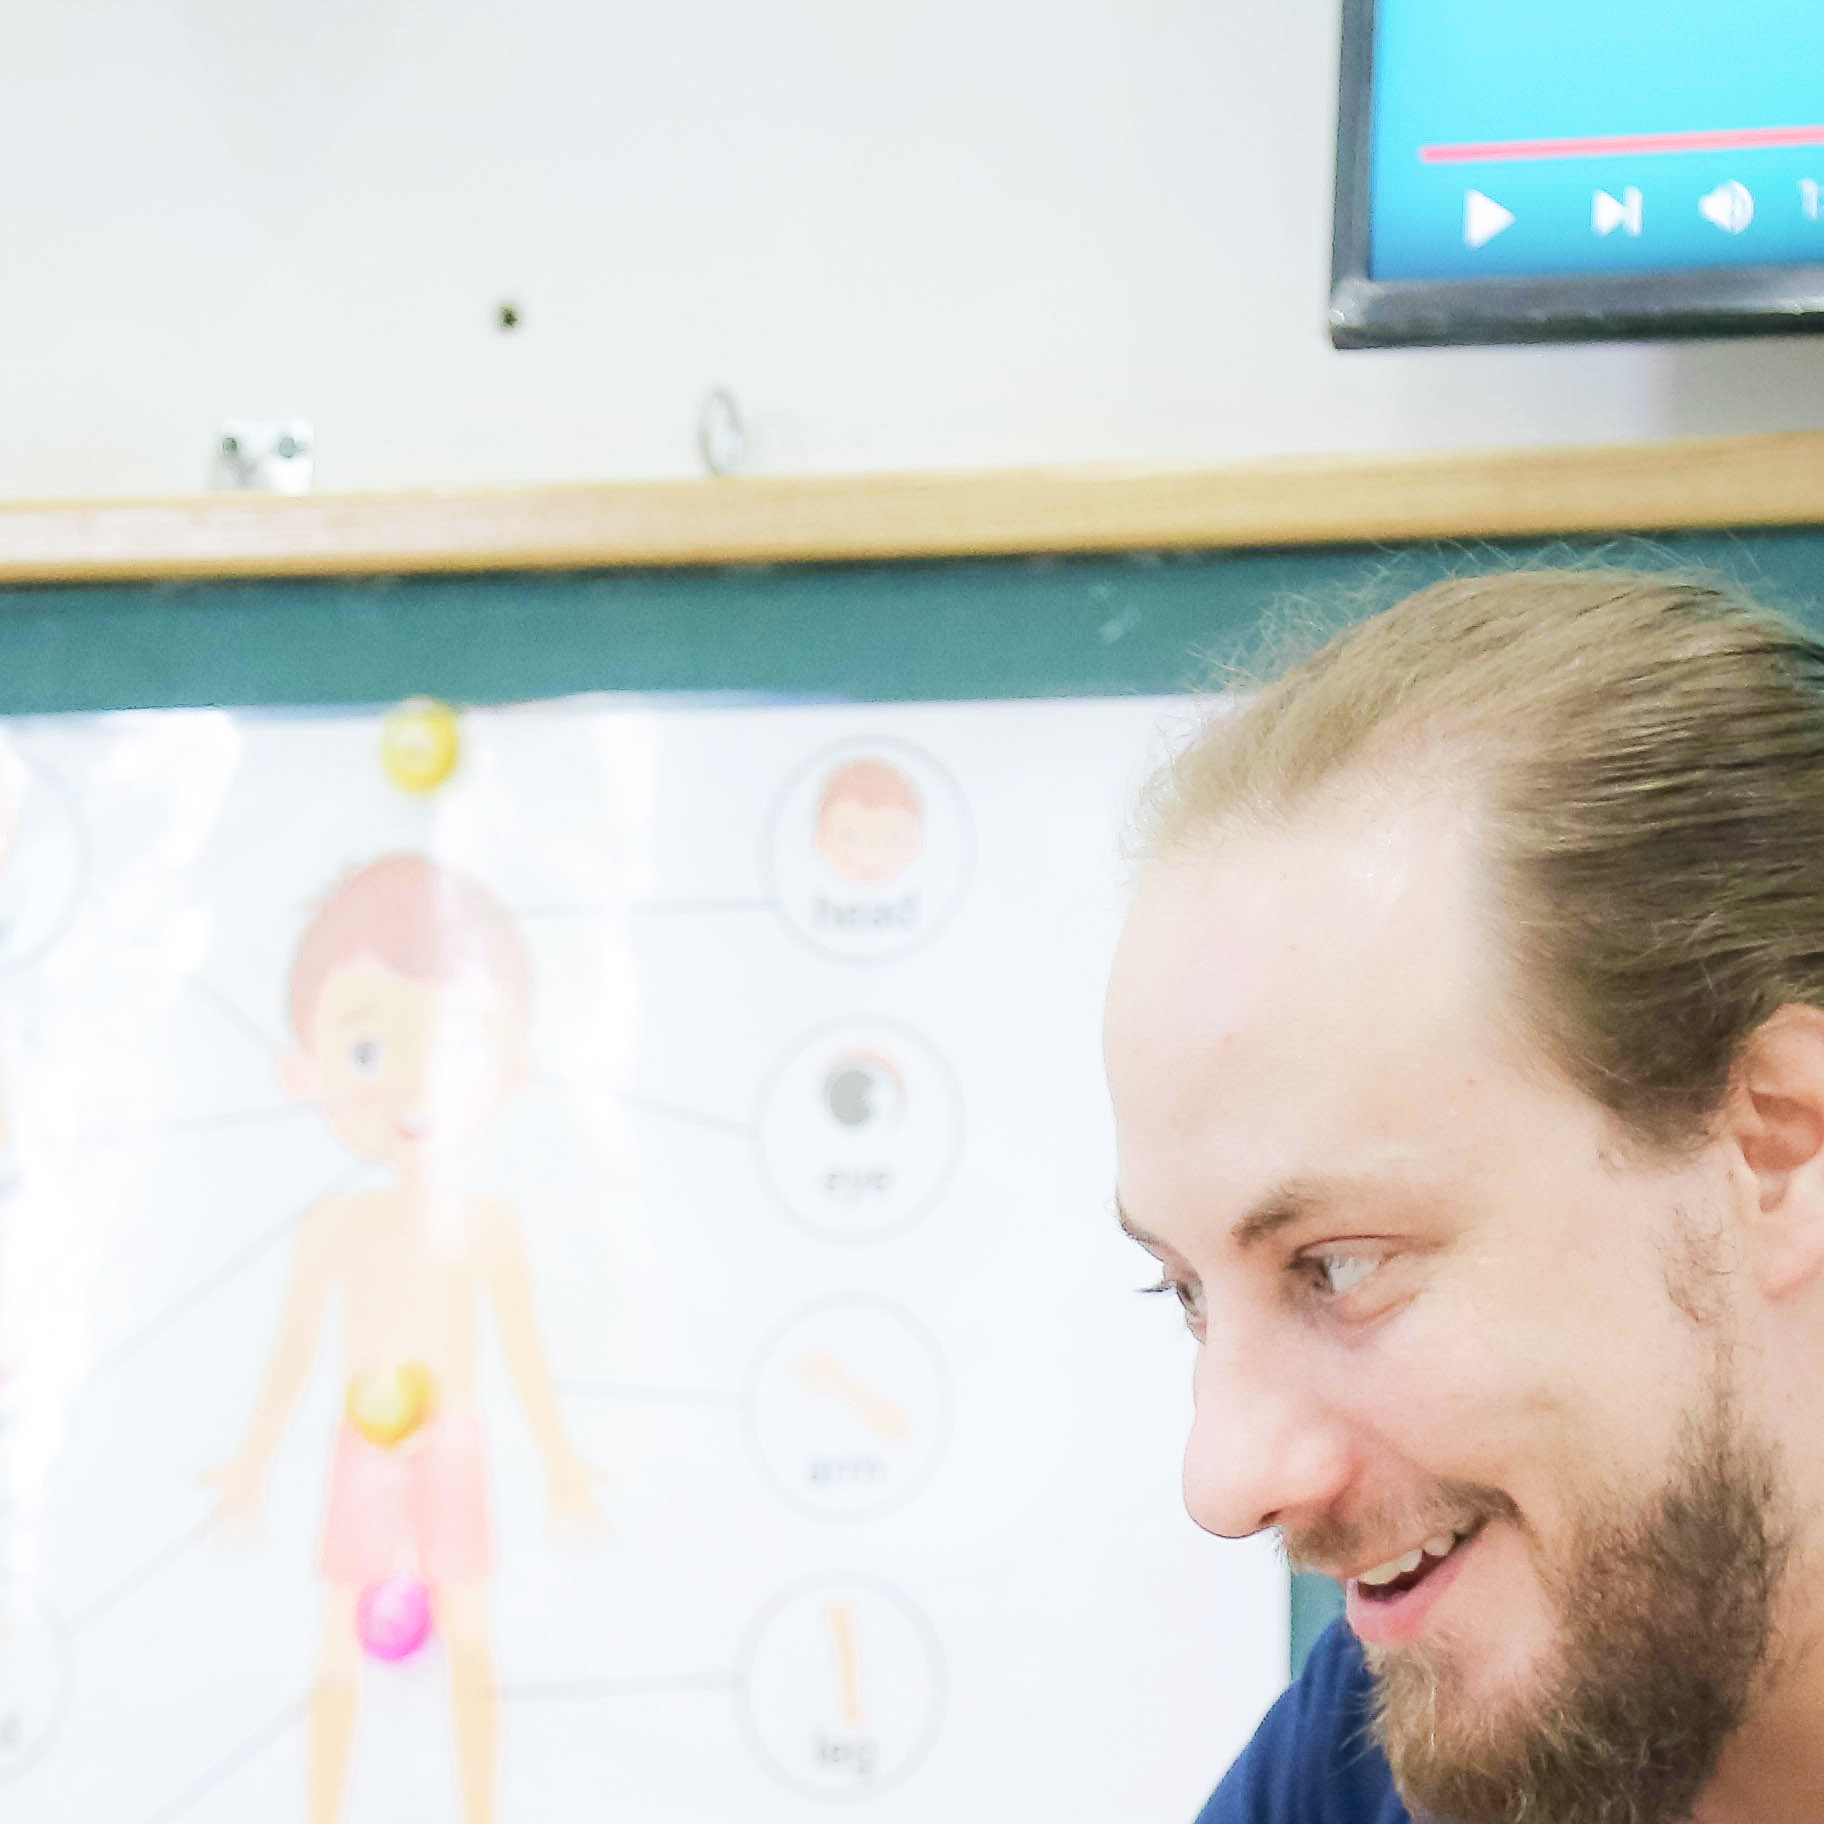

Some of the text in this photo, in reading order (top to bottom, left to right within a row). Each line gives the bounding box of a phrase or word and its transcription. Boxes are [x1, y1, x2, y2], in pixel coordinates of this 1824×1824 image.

[810, 887, 920, 930] head
[821, 1166, 895, 1207] eye
[811, 1728, 878, 1785] leg
